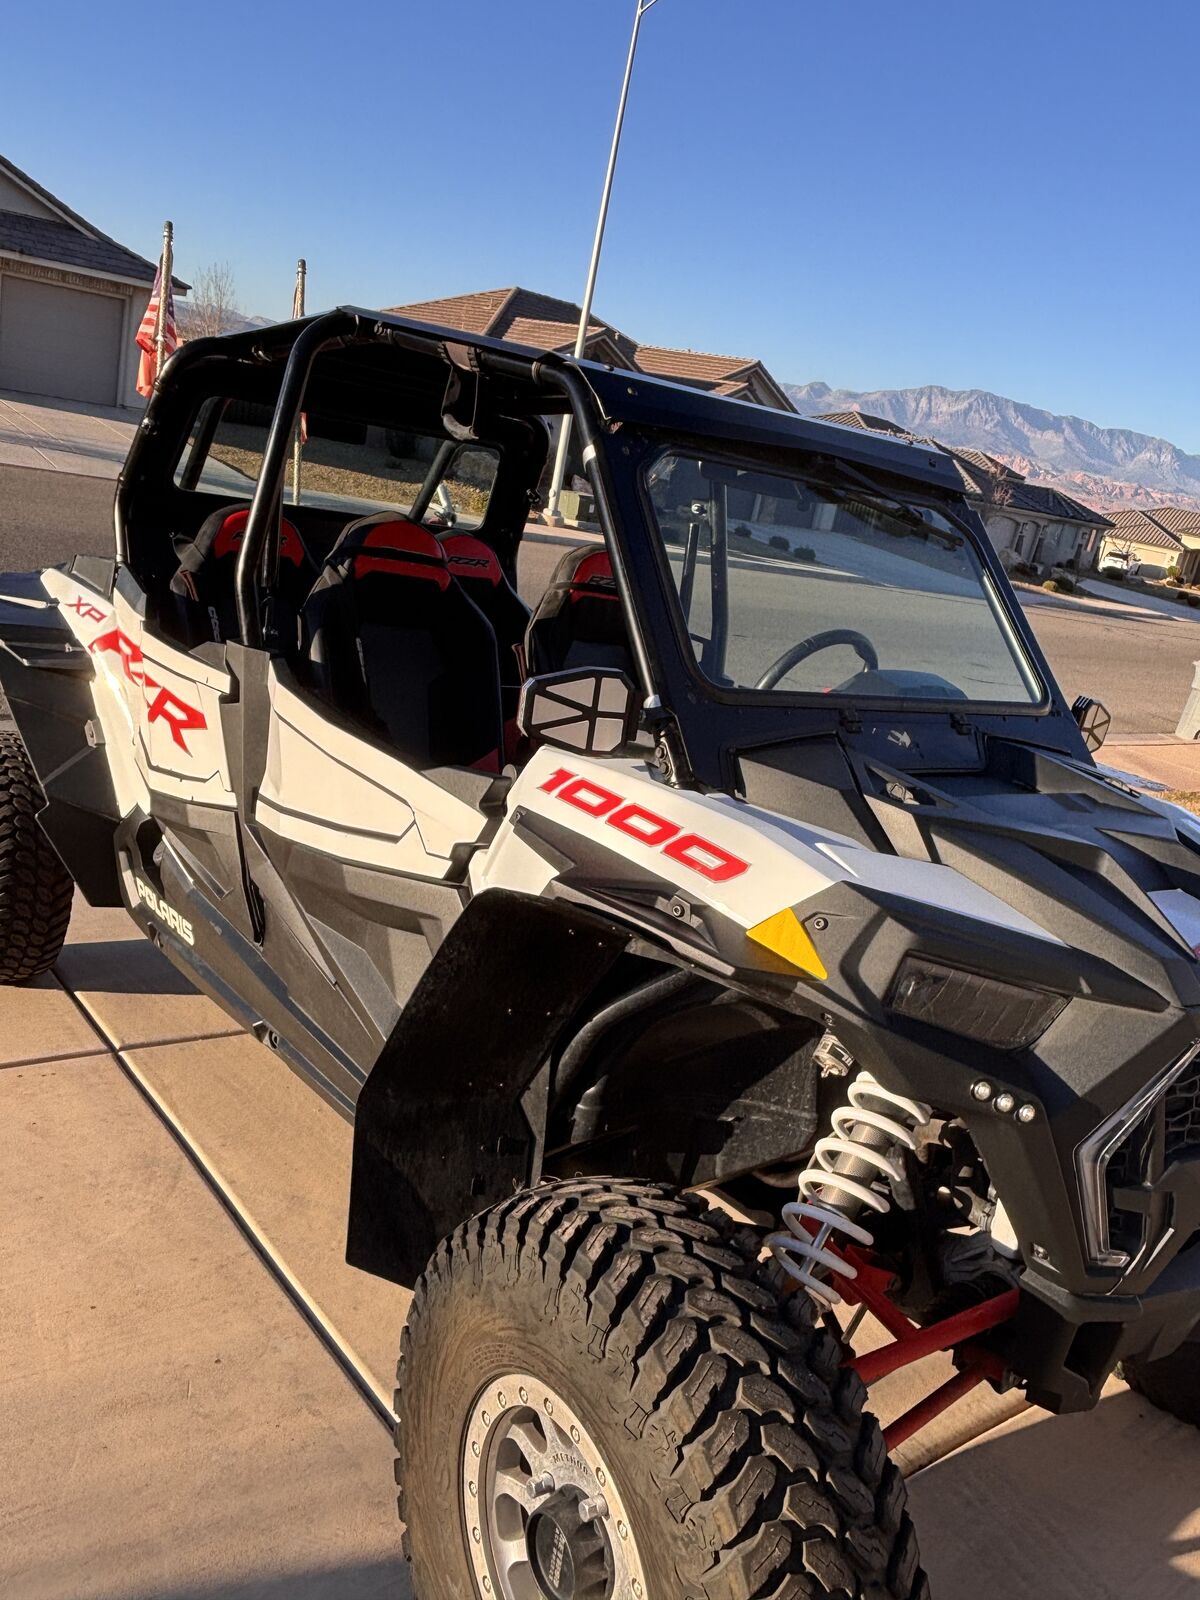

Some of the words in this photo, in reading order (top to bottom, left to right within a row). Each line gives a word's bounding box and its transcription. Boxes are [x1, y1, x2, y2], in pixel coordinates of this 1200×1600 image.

[66, 596, 107, 623] XP
[536, 767, 752, 883] 1000
[136, 876, 195, 946] POLARIS
